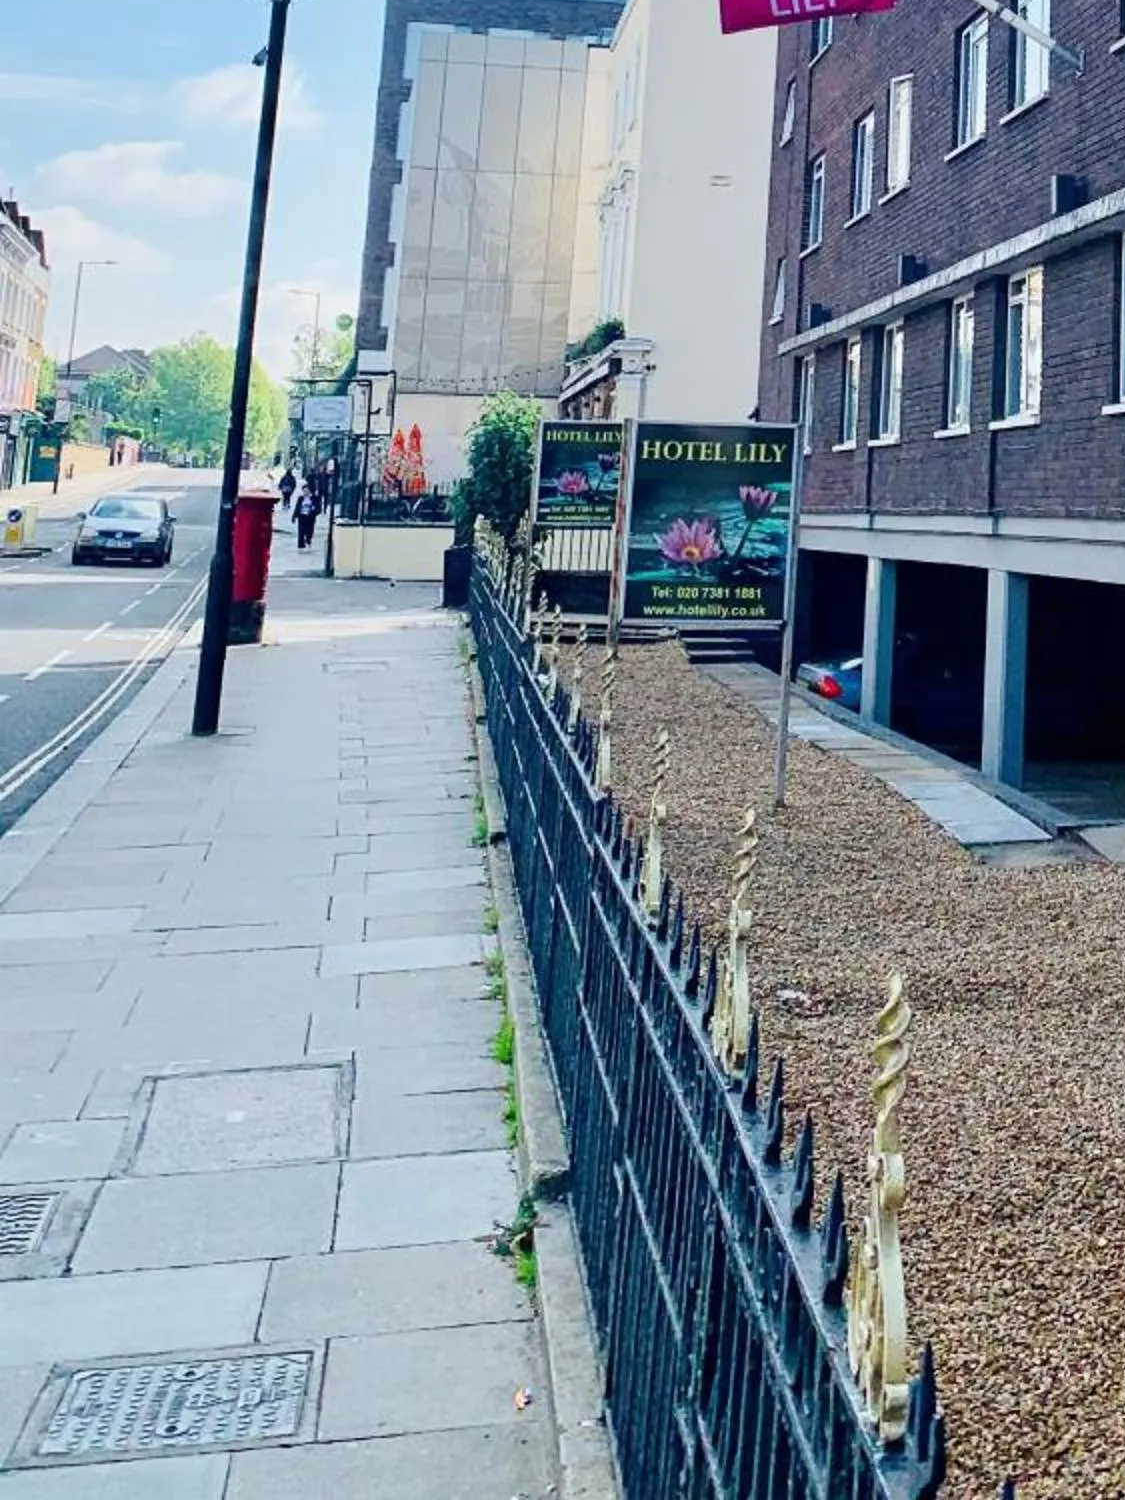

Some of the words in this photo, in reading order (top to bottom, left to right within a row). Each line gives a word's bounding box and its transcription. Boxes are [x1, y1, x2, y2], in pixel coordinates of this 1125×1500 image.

[546, 429, 589, 442] HOTEL
[595, 430, 622, 443] LILY
[641, 440, 727, 461] HOTEL
[734, 443, 788, 463] LILY
[651, 586, 673, 599] Tel:
[677, 587, 699, 599] 020
[702, 587, 730, 599] 7381
